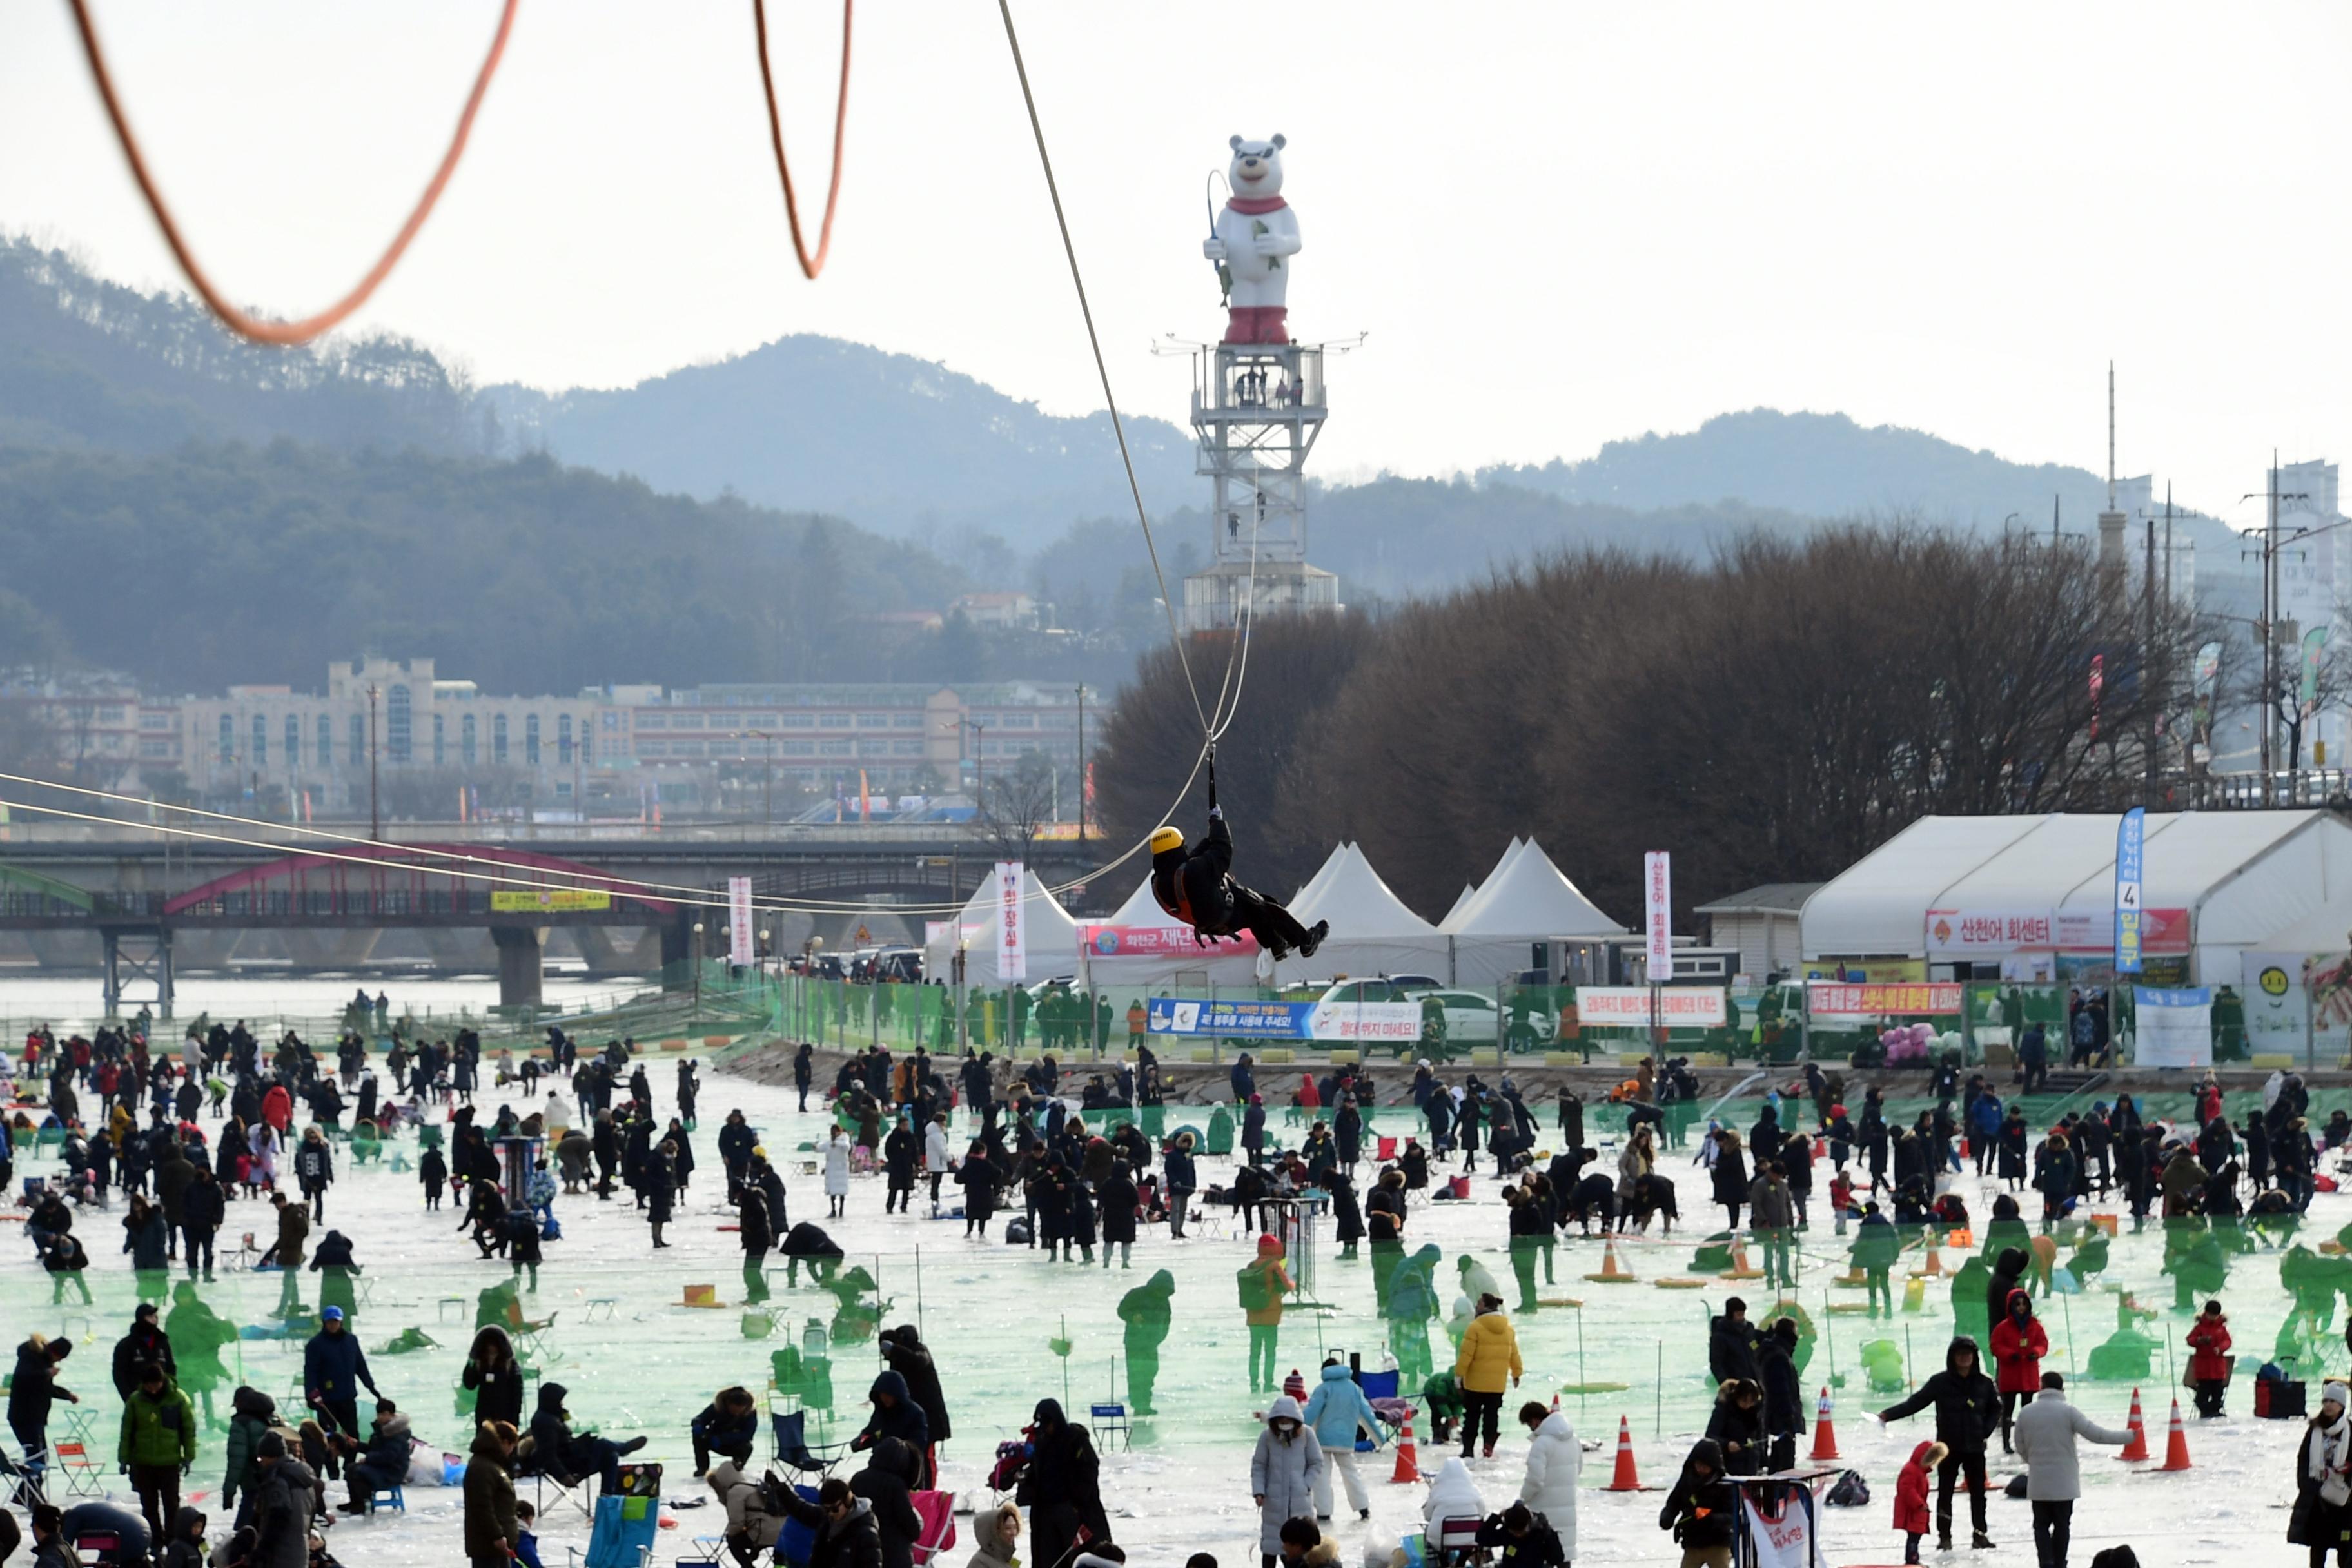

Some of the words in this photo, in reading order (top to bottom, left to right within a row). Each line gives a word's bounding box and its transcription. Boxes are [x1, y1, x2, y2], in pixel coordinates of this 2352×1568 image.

[1652, 861, 1664, 905] 산천어
[2123, 885, 2135, 906] 4
[1004, 890, 1017, 946] 화장실
[1961, 917, 2003, 942] 산천어
[2007, 917, 2050, 943] 회센터
[1126, 934, 1157, 946] 화천군
[1653, 914, 1665, 957] 회센터
[2119, 913, 2139, 966] 입출구
[1264, 1015, 1292, 1027] 주세요!
[1382, 1021, 1416, 1036] 마세요!
